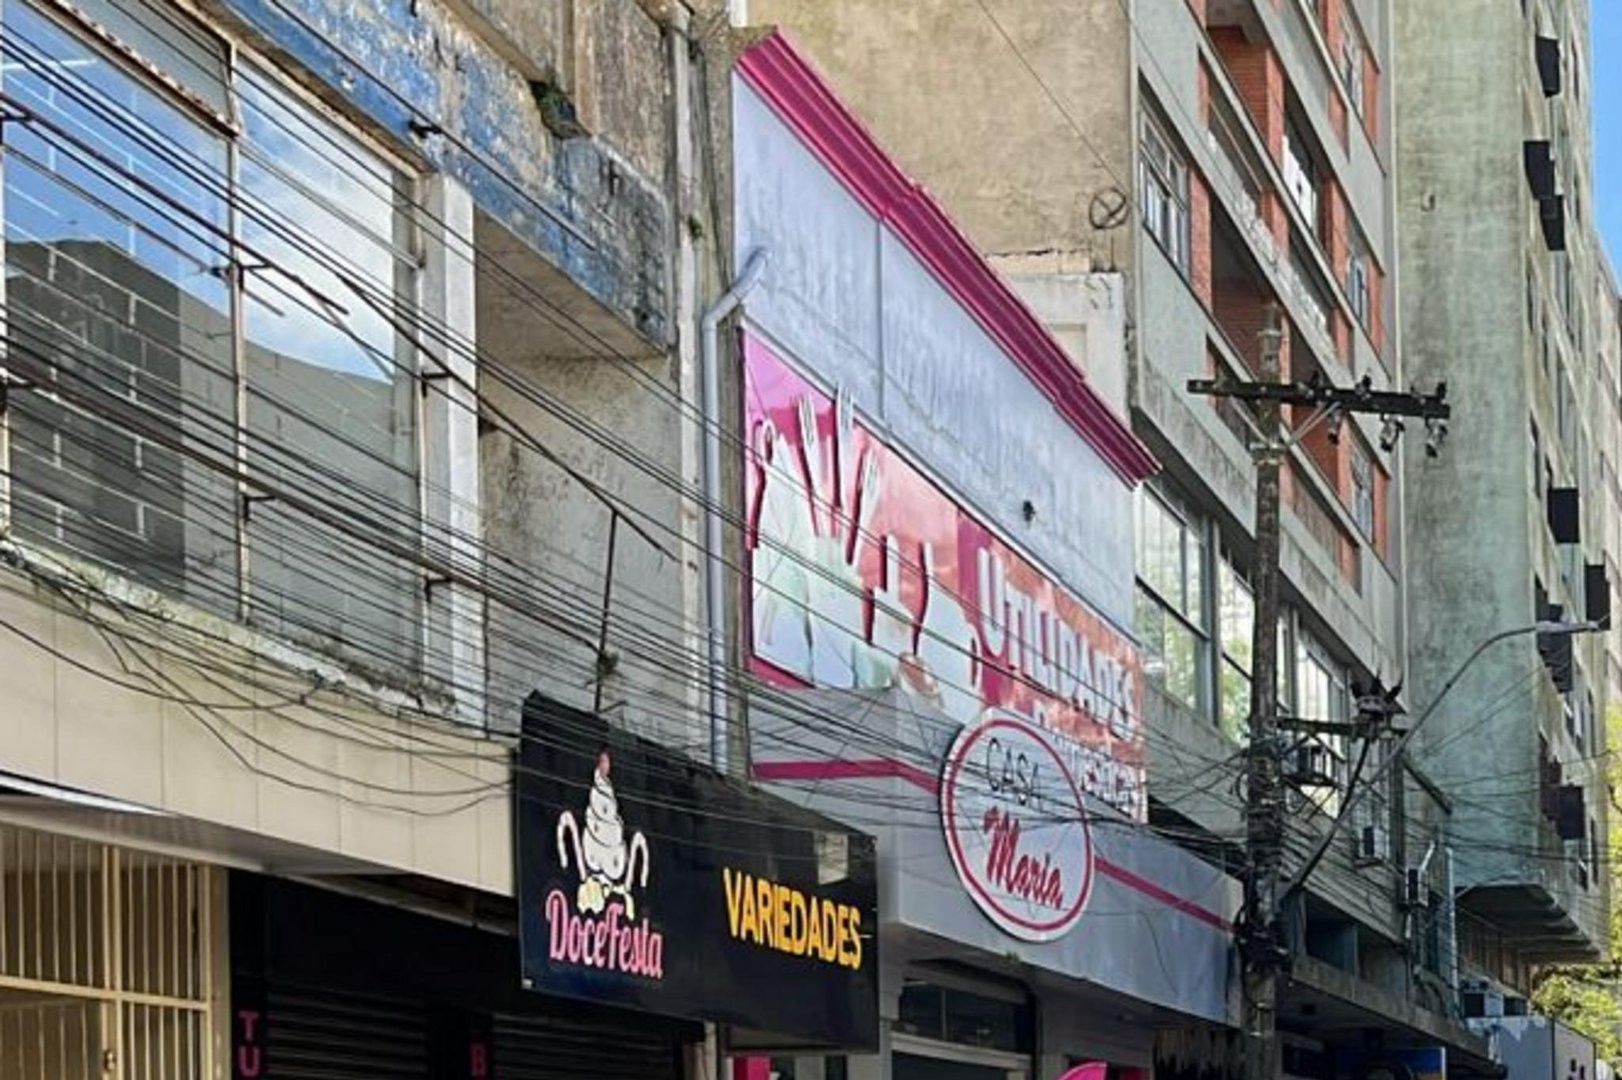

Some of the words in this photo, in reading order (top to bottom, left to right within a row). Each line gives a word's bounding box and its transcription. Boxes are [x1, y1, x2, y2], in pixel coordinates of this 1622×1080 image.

[977, 547, 1134, 742] UTILIDADES
[987, 737, 1043, 813] CASA
[984, 806, 1063, 911] Maria
[723, 867, 862, 970] VARIEDADES
